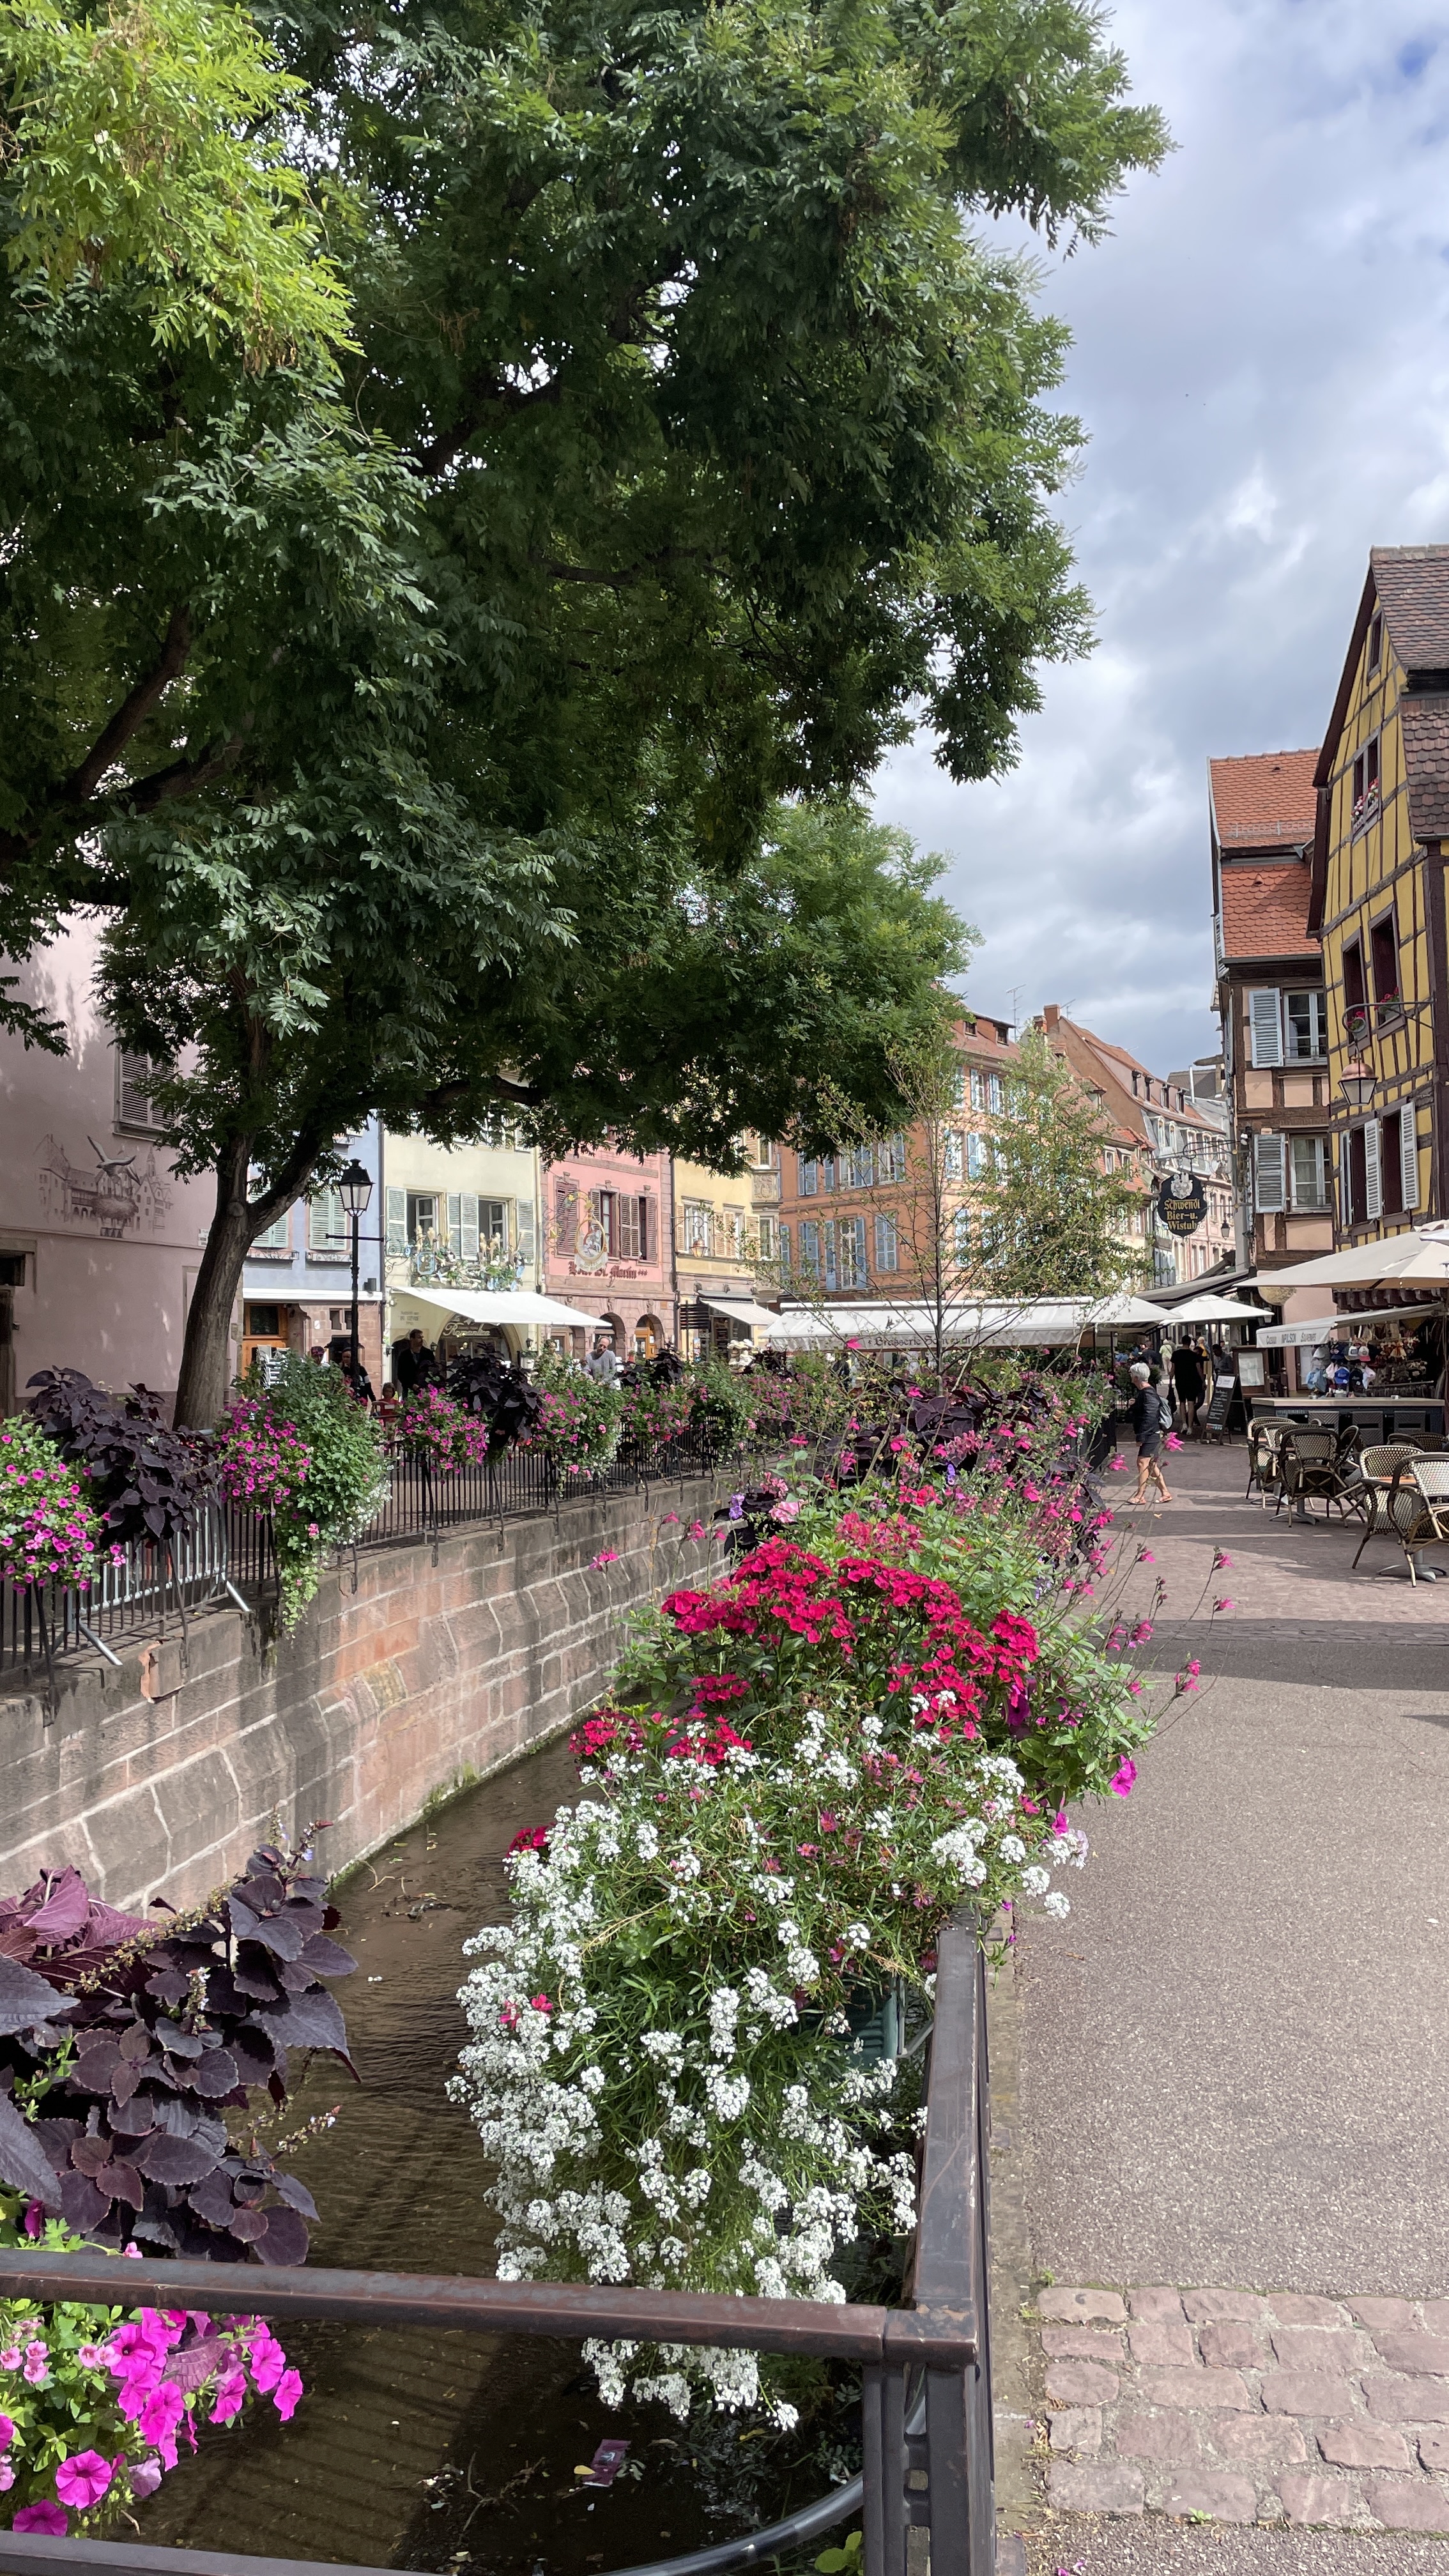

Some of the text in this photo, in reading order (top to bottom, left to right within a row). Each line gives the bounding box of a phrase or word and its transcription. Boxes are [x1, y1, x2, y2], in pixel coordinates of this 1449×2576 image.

[1164, 1199, 1200, 1210] Schwendi
[1168, 1220, 1197, 1230] Wistub
[874, 1337, 920, 1346] Brasserie
